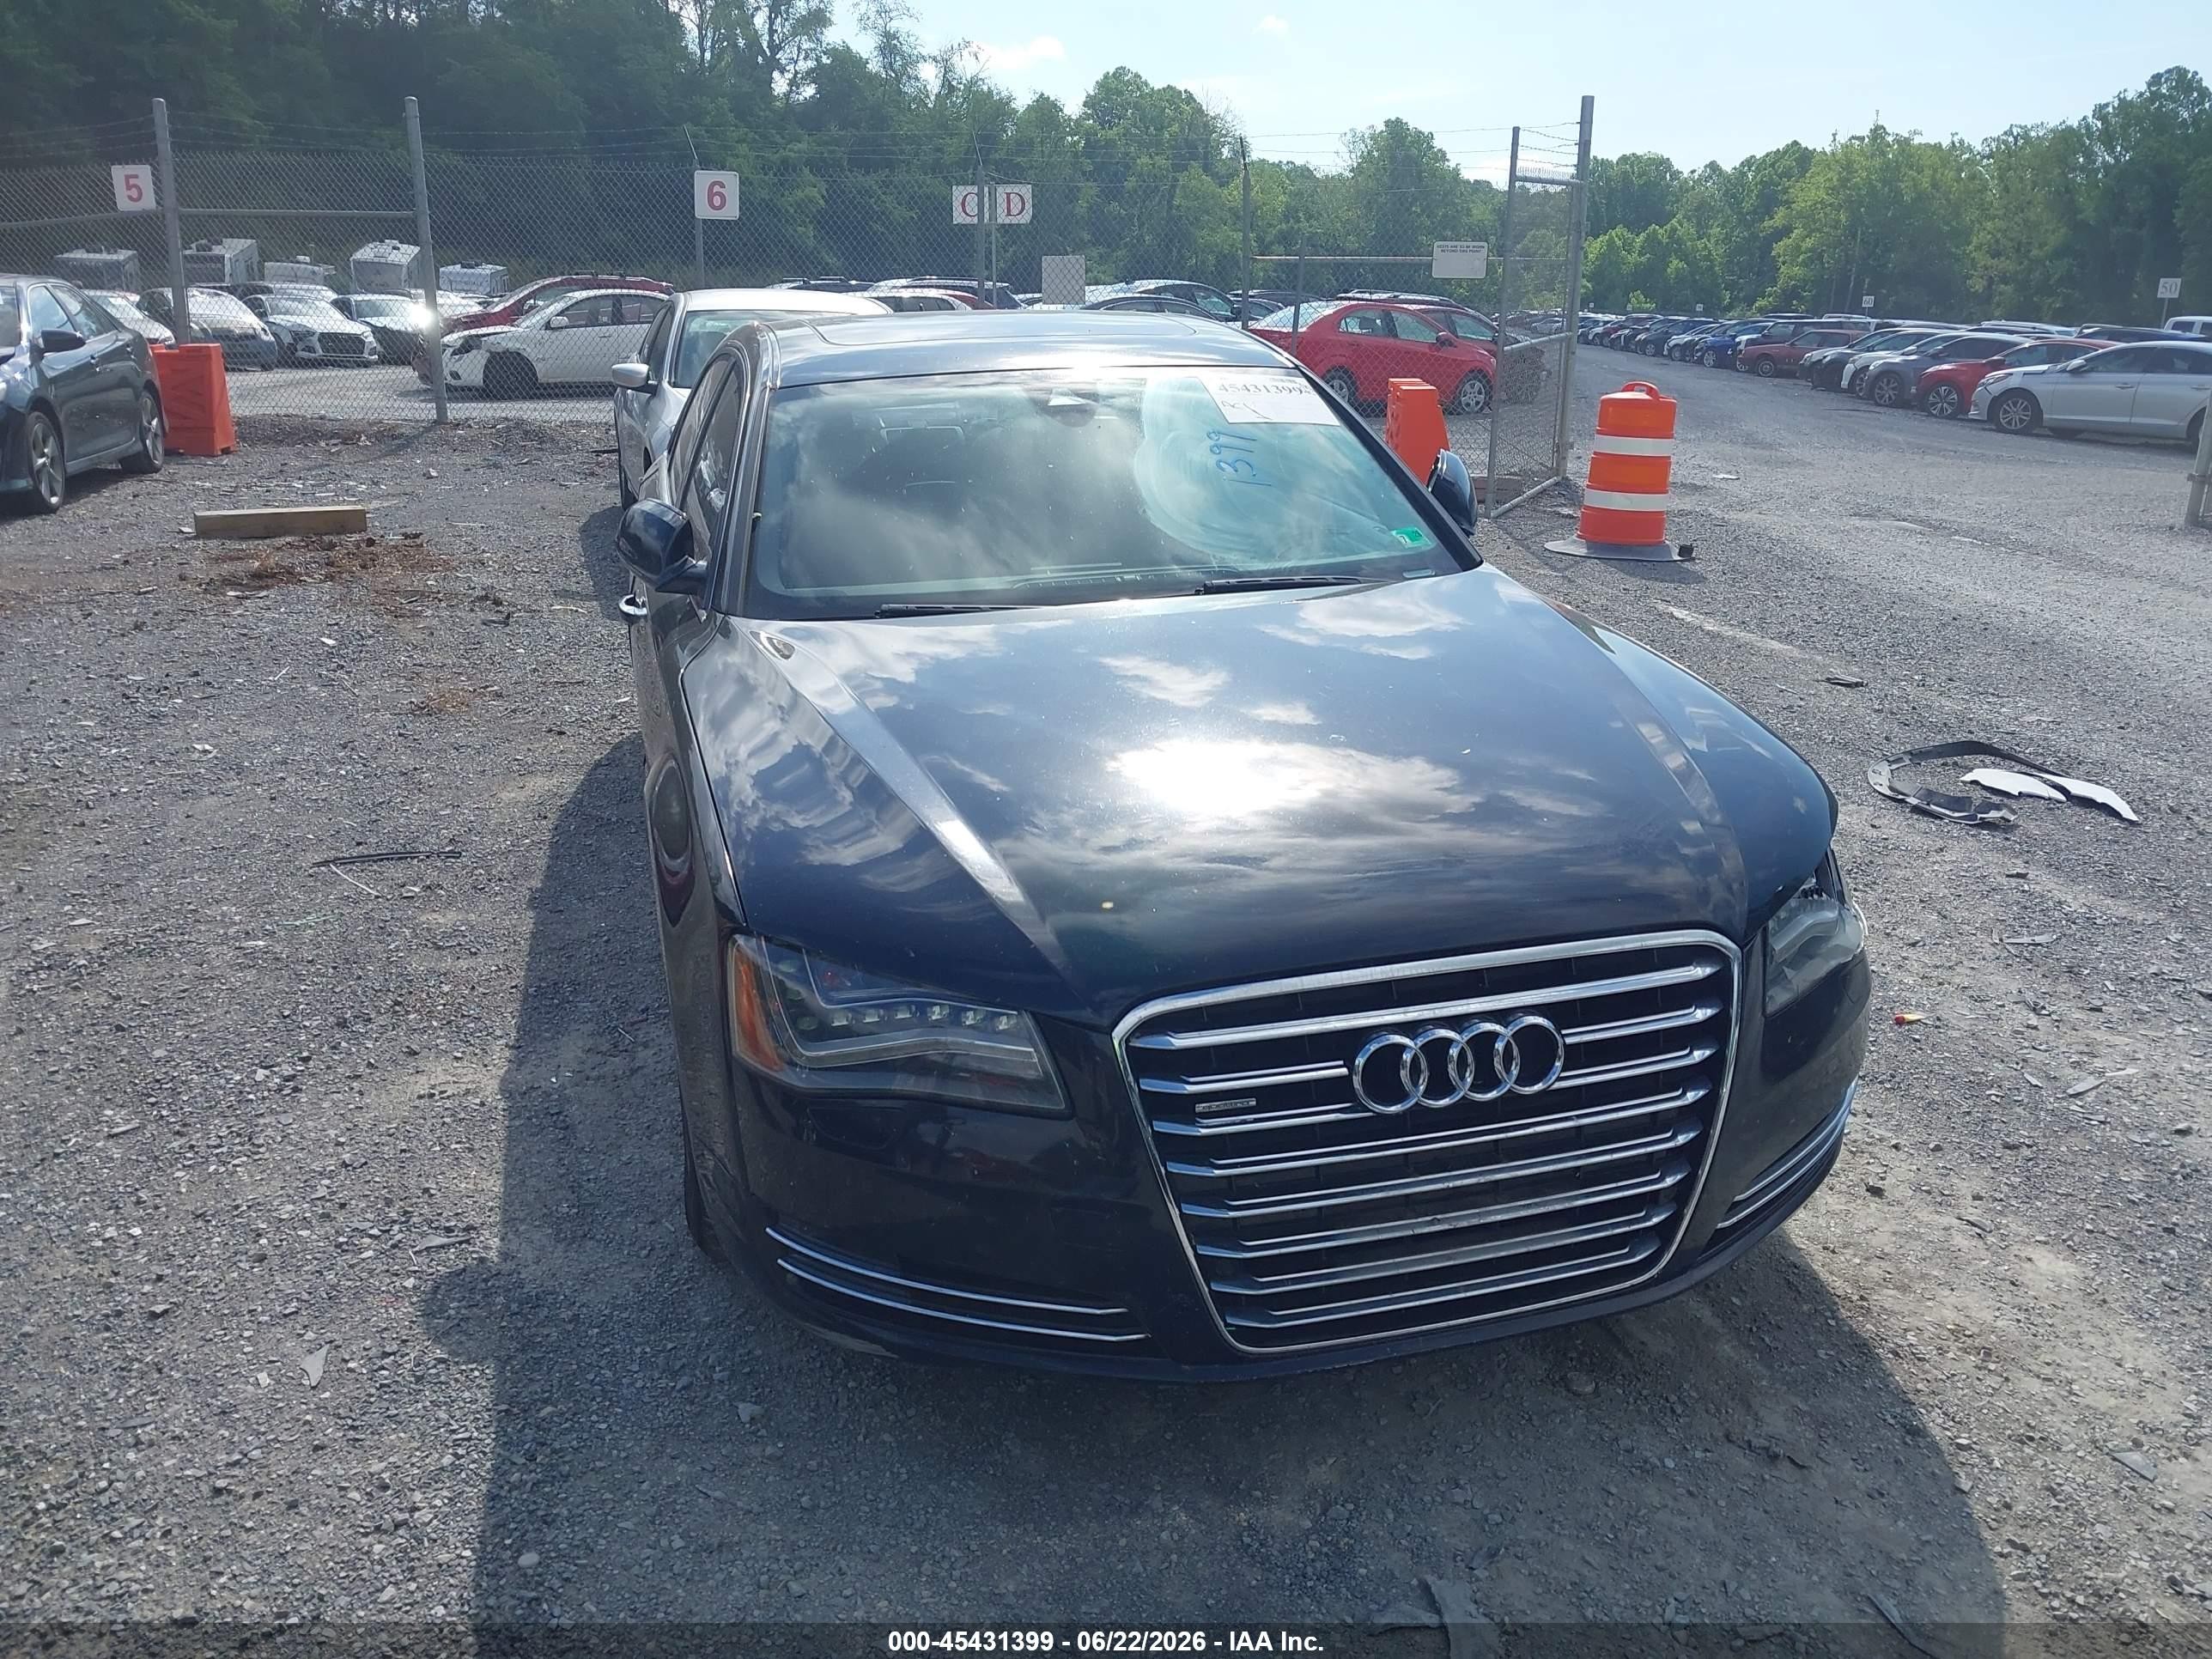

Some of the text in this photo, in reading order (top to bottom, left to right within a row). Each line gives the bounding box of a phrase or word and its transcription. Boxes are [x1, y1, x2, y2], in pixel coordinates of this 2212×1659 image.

[124, 173, 143, 203] 5
[707, 180, 726, 211] 6
[1004, 191, 1026, 217] D
[2161, 282, 2178, 294] 50
[1218, 383, 1304, 395] 45431399
[1206, 430, 1273, 487] 1399
